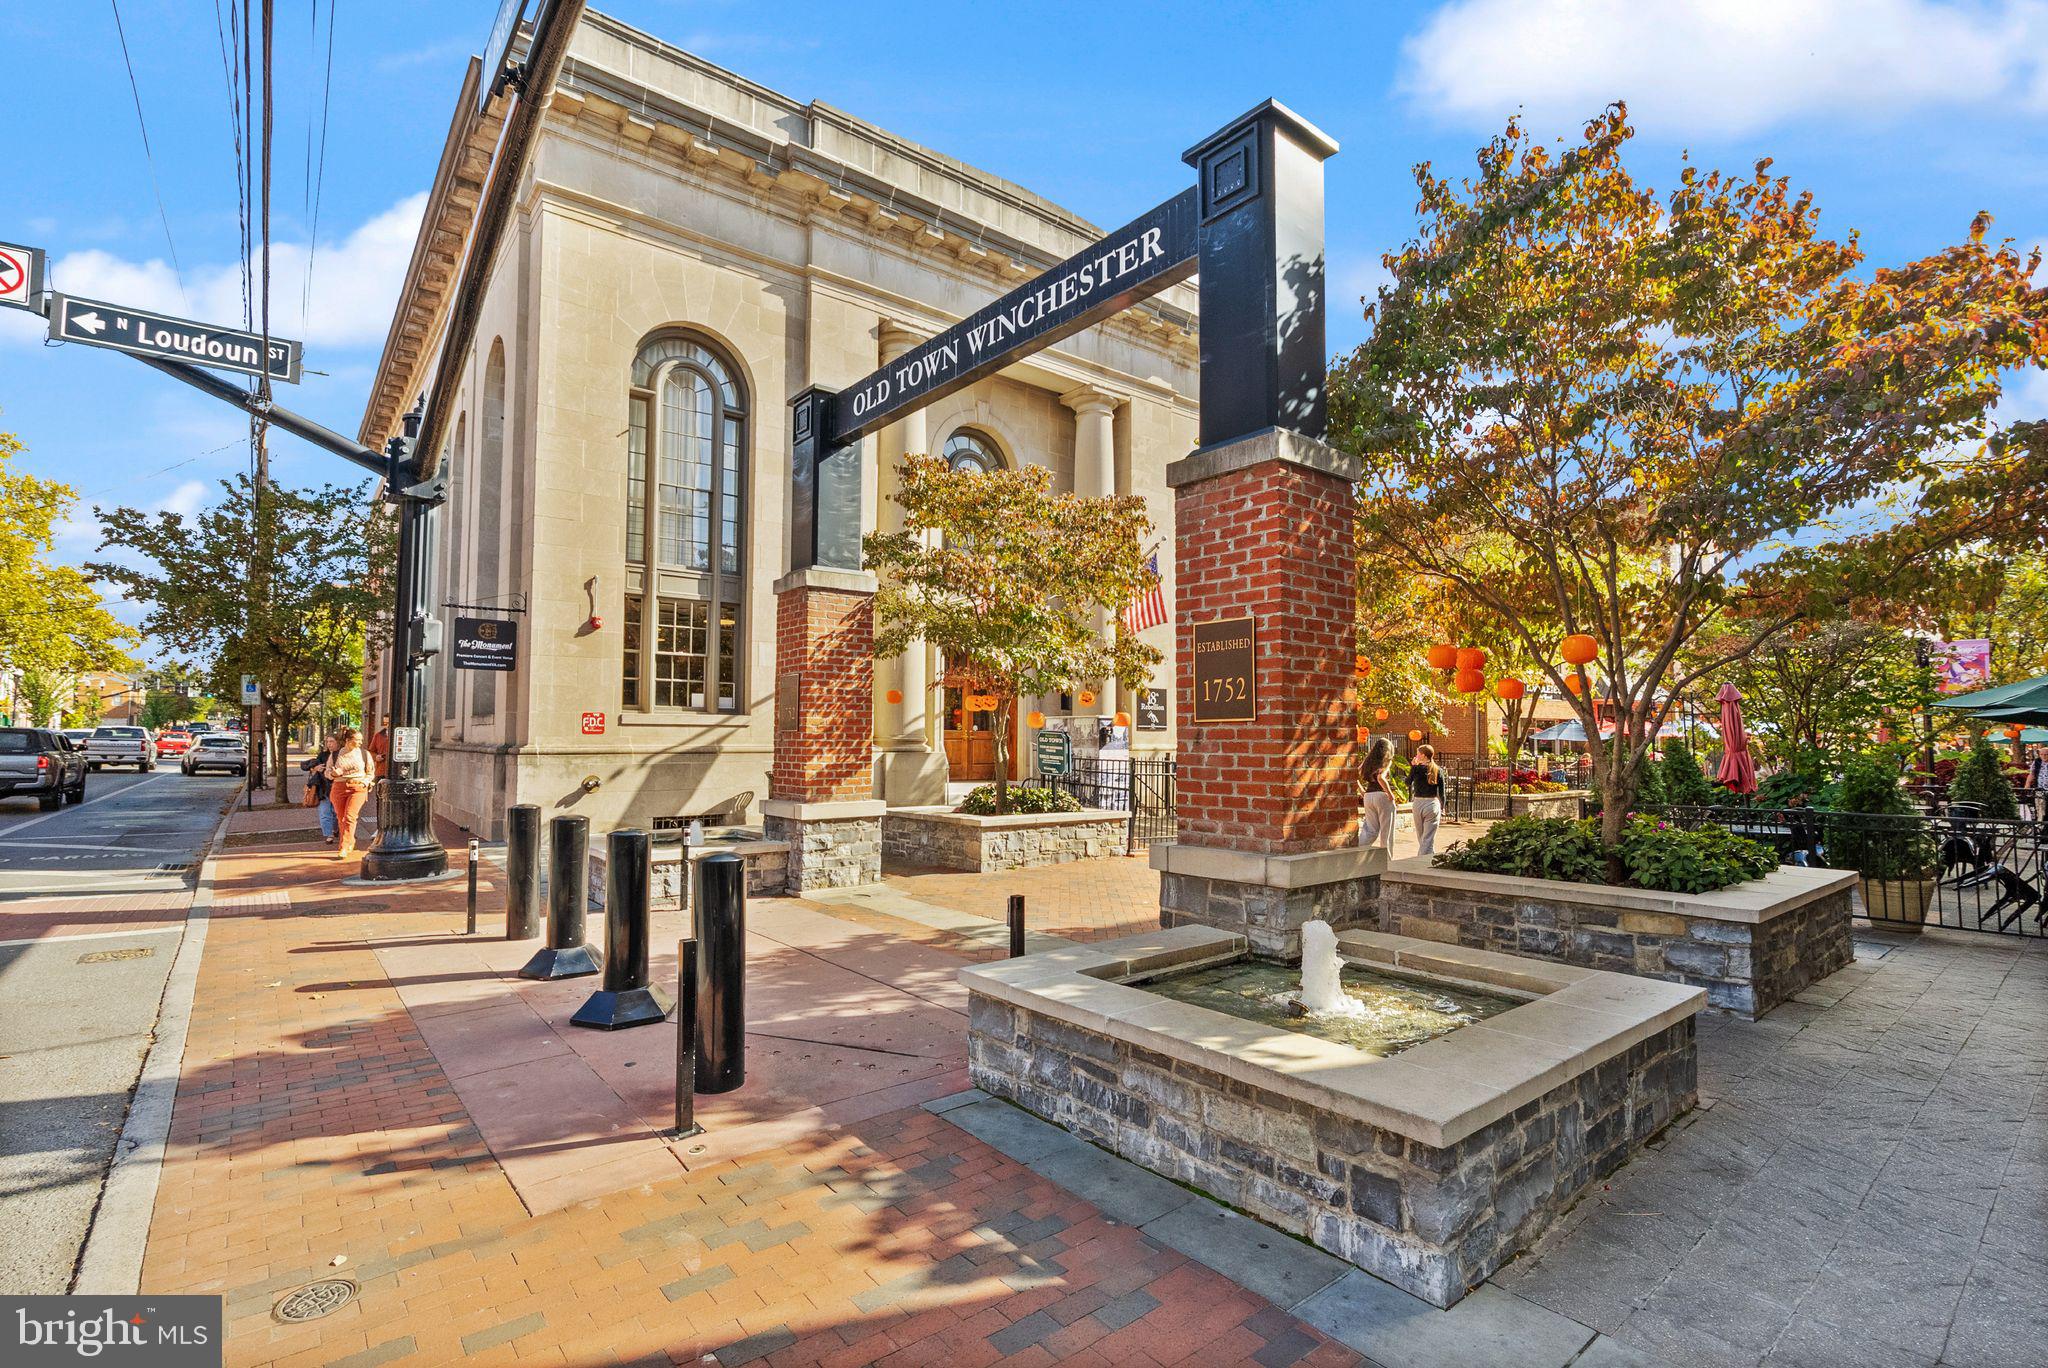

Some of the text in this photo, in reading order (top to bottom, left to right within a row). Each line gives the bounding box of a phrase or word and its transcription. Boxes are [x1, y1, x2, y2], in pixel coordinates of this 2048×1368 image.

[853, 226, 1165, 417] OLD TOWN WINCHESTER
[116, 317, 286, 365] N Loudoun ST
[458, 639, 513, 651] The Monument
[1197, 638, 1251, 653] ESTABLISHED
[1204, 677, 1246, 703] 1752
